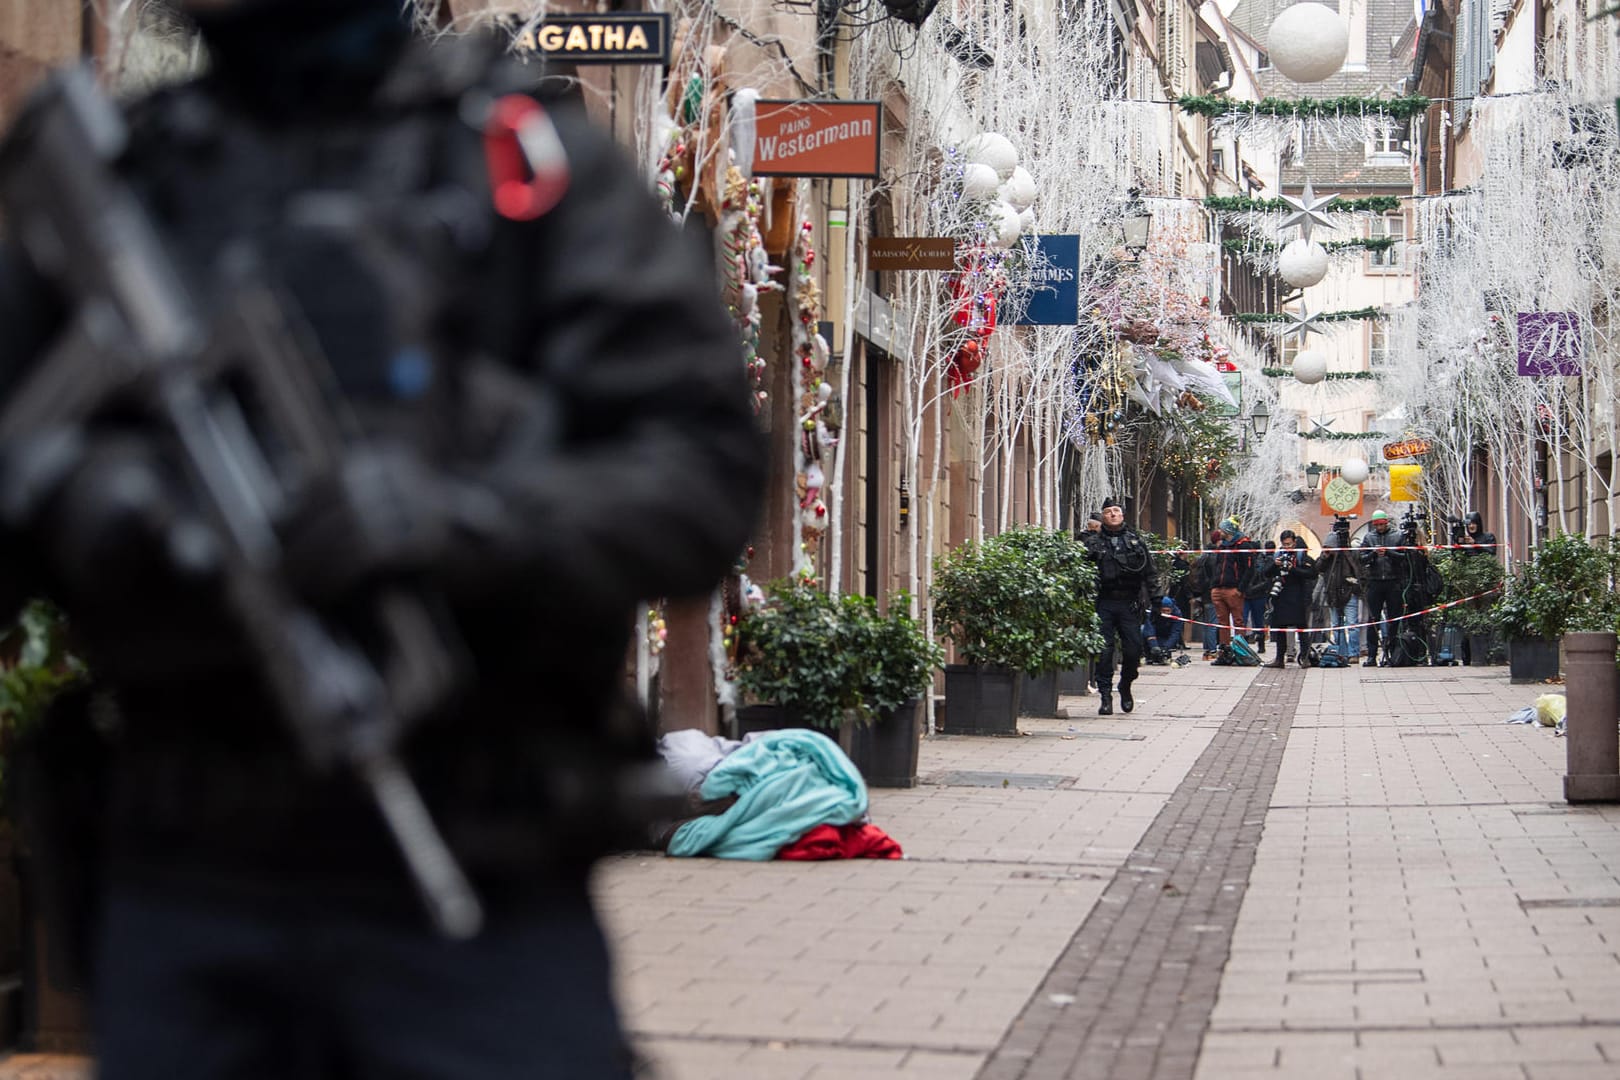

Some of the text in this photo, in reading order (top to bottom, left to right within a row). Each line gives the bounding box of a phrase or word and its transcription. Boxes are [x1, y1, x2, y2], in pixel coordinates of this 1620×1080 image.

[515, 24, 649, 51] AGATHA
[779, 116, 811, 136] PAINS
[759, 119, 872, 161] Westermann
[871, 249, 909, 258] MAISON
